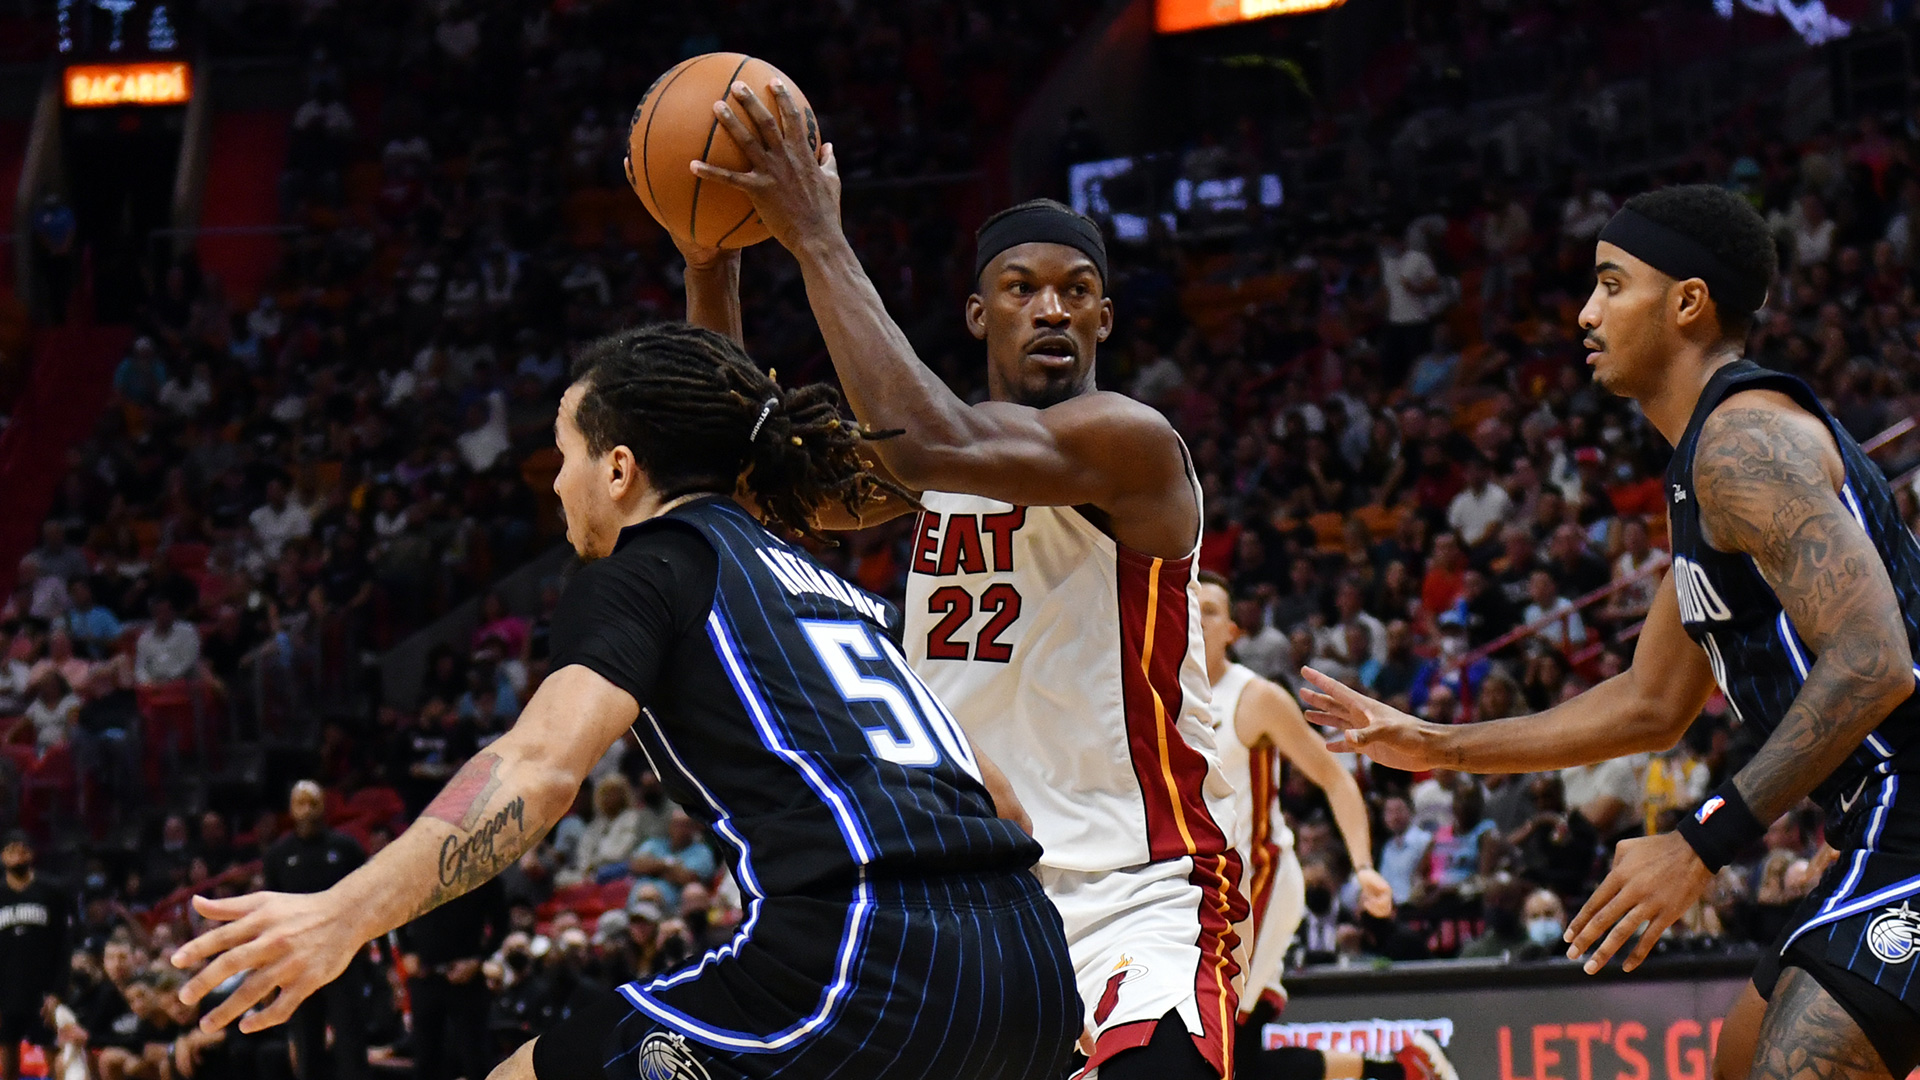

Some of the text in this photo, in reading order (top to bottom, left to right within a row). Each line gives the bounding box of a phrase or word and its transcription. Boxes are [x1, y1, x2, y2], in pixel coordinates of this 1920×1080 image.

[911, 505, 1028, 577] EAT
[754, 546, 889, 629] ANTHONY
[926, 583, 1022, 664] 22
[797, 617, 985, 786] 50
[438, 795, 524, 888] Gregory
[1497, 1017, 1724, 1080] LET'S G
